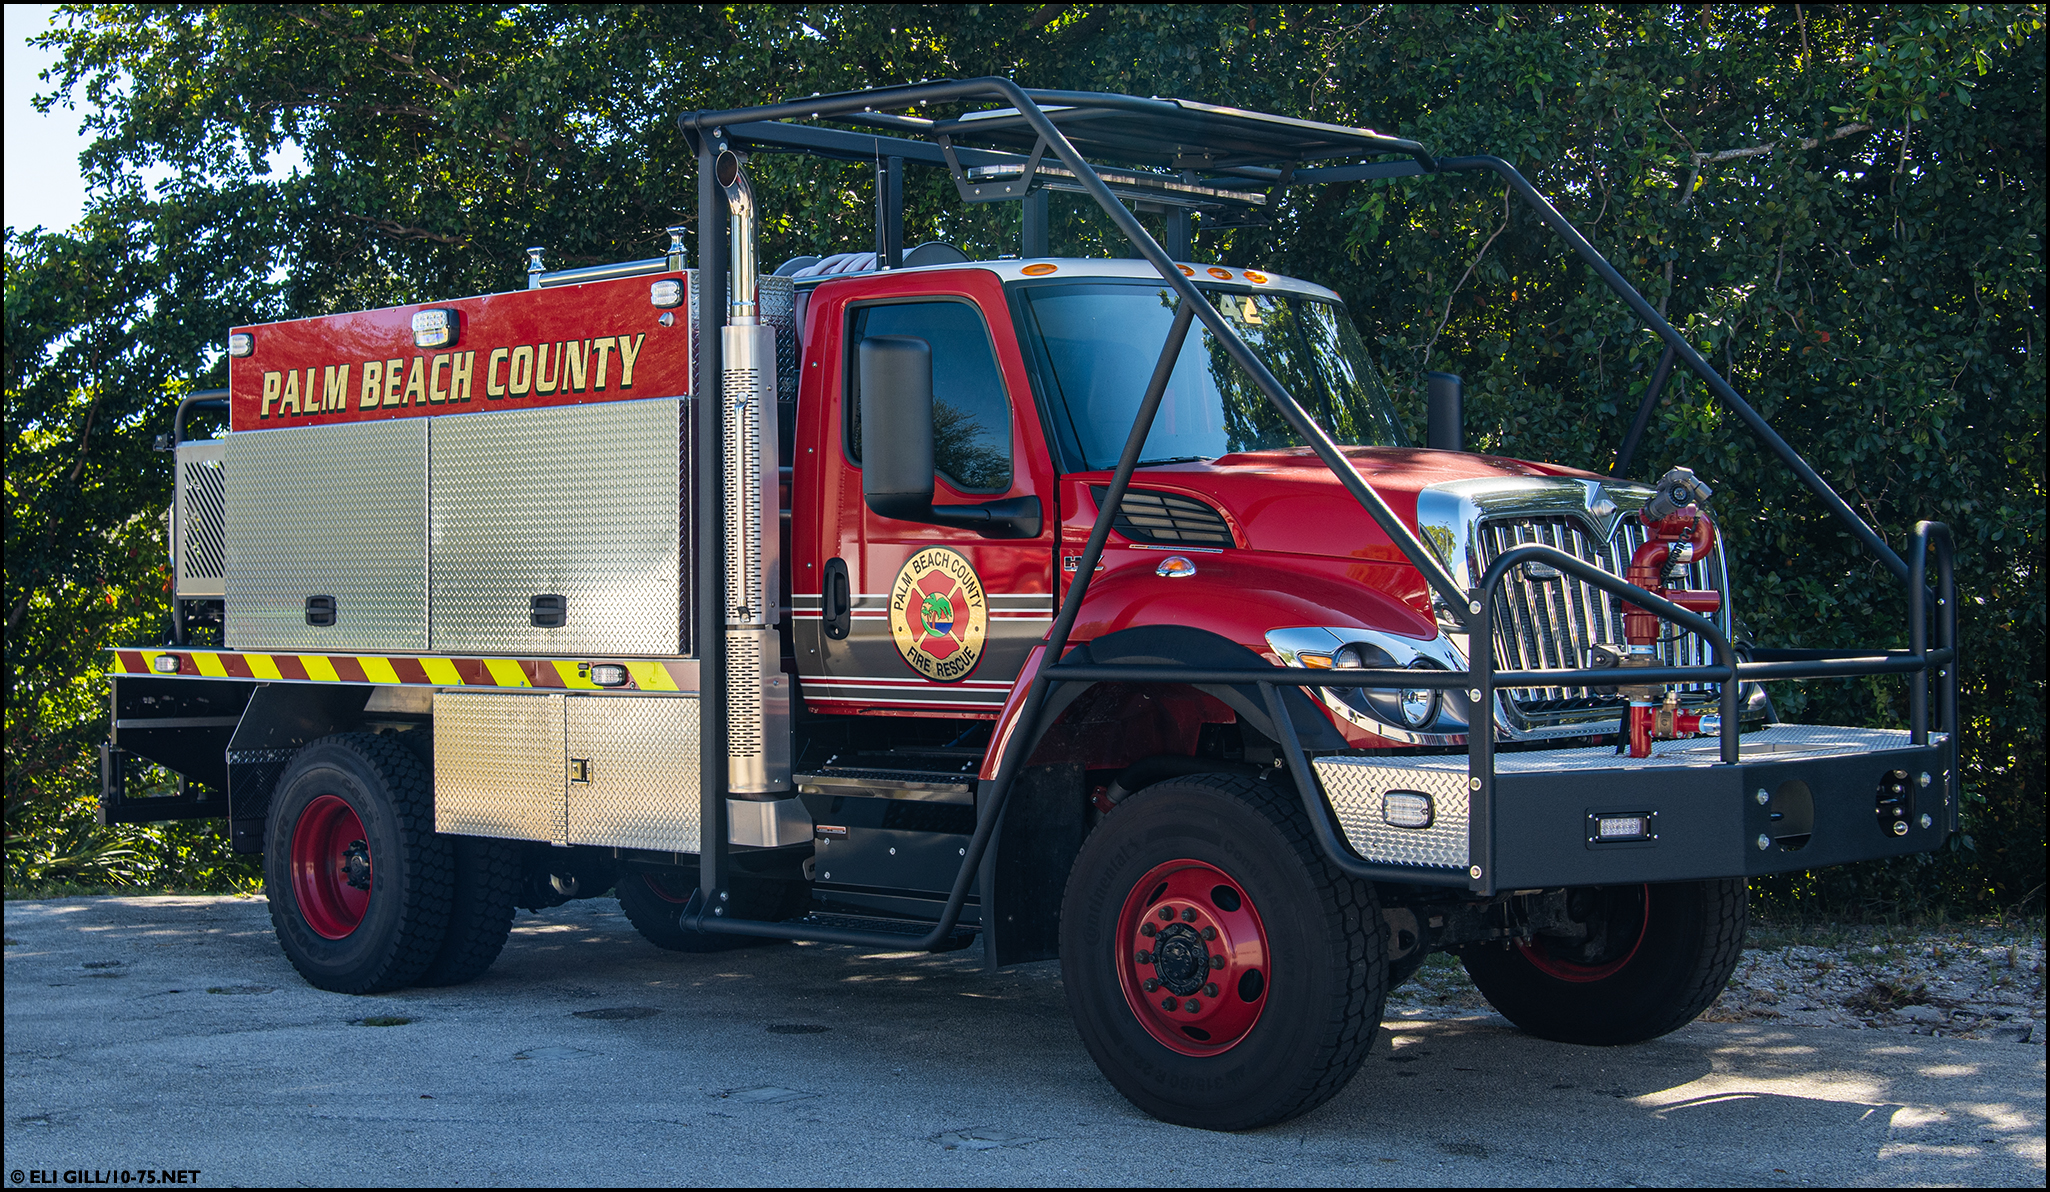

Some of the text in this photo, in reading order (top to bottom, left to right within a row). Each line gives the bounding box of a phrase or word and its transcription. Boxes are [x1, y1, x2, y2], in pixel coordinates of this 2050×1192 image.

[1219, 294, 1263, 325] 42
[260, 333, 646, 419] PALM BEACH COUNTY
[894, 551, 983, 611] PALM BEACH COUNTY
[906, 646, 976, 677] FIRE RESCUE
[1082, 844, 1132, 947] Continental
